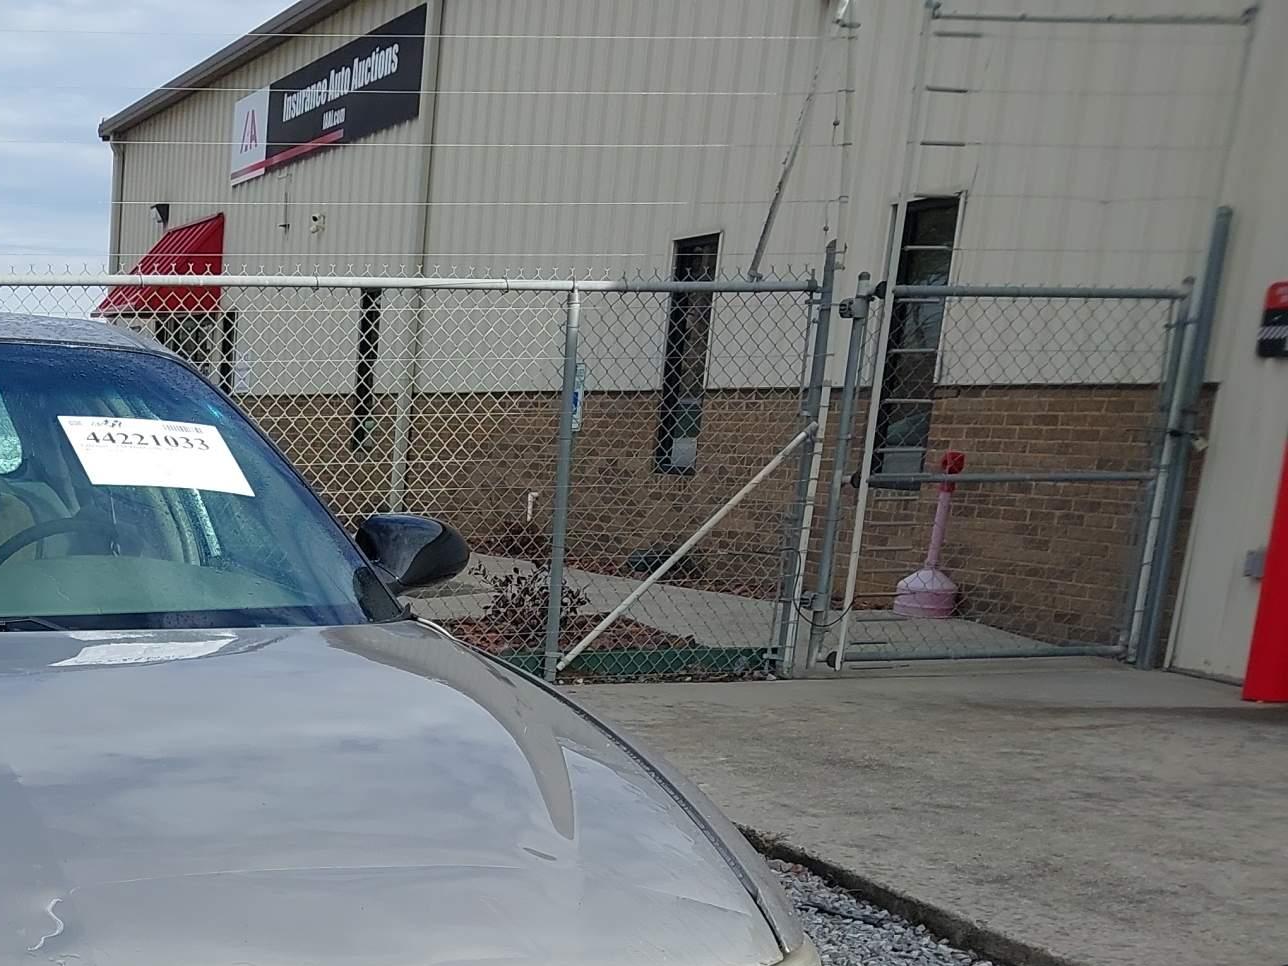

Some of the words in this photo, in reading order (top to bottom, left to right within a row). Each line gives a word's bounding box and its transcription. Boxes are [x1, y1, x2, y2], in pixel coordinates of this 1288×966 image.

[282, 78, 328, 122] Insurance
[327, 66, 351, 102] Auto
[351, 43, 399, 92] Auctions
[86, 431, 210, 451] 44221033
